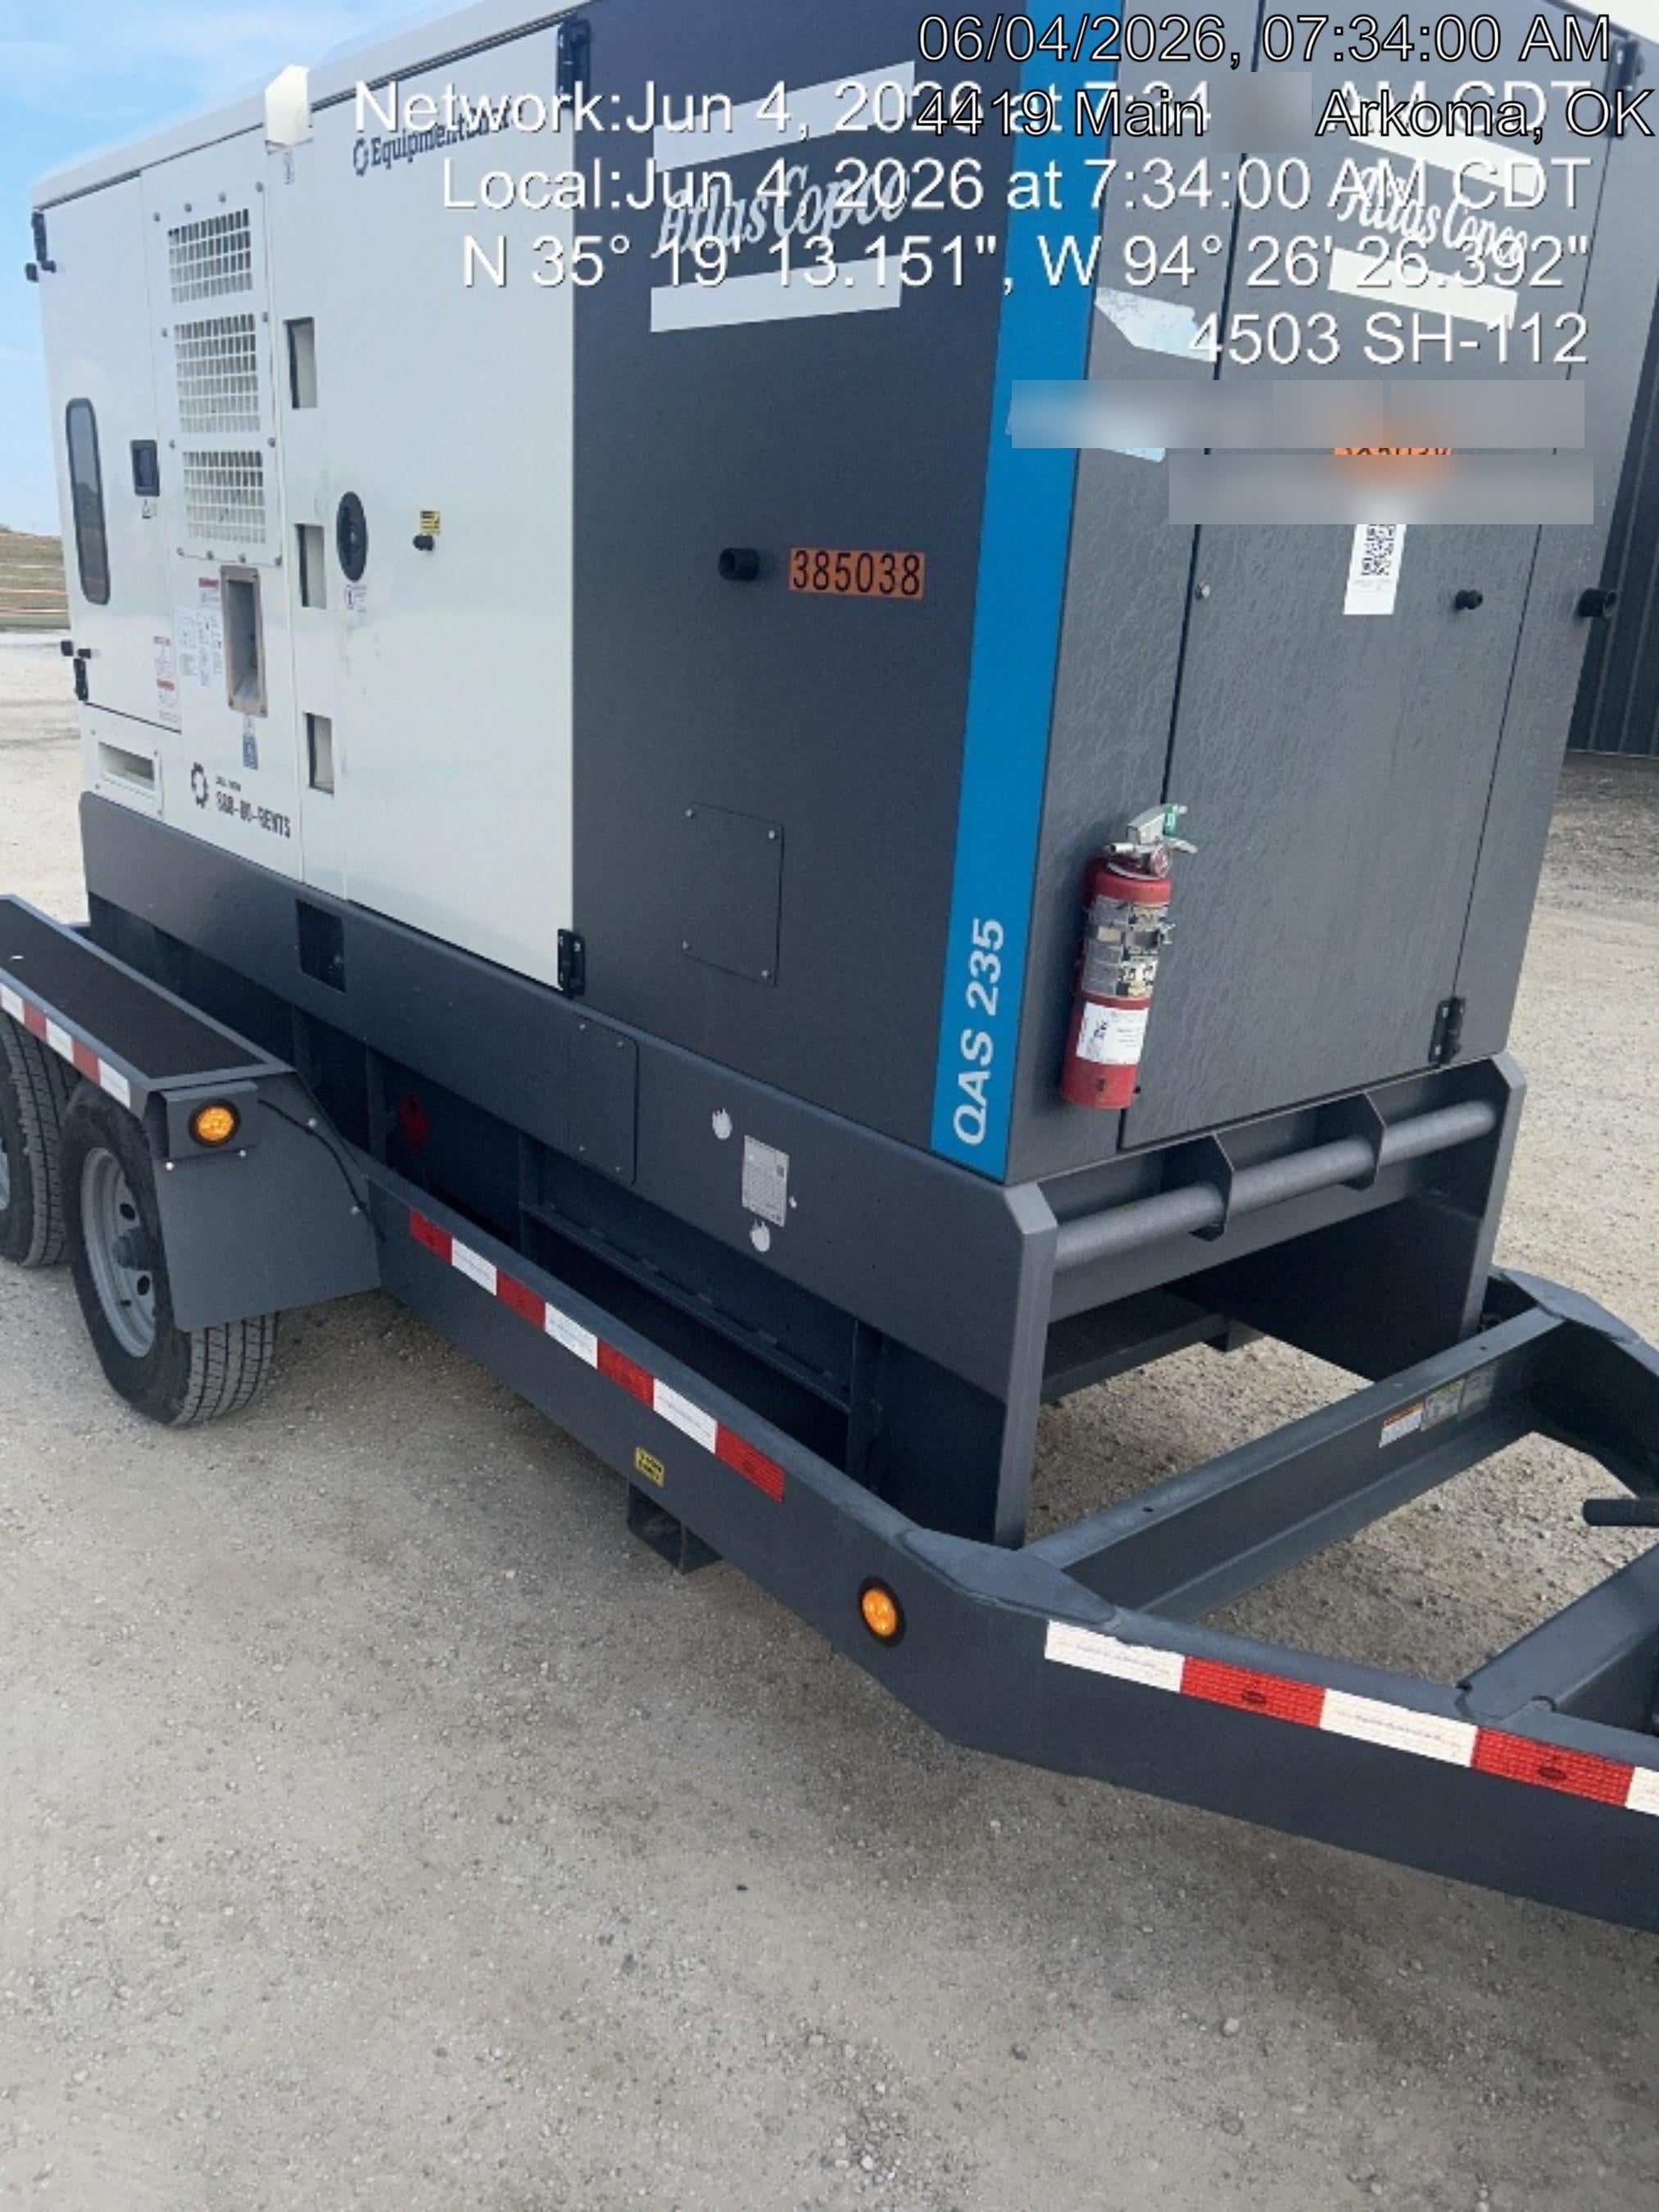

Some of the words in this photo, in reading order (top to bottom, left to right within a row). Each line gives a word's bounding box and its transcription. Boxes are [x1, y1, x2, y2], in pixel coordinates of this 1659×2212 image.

[792, 550, 921, 596] 385038
[965, 918, 1004, 1016] 235
[953, 1028, 995, 1146] QAS
